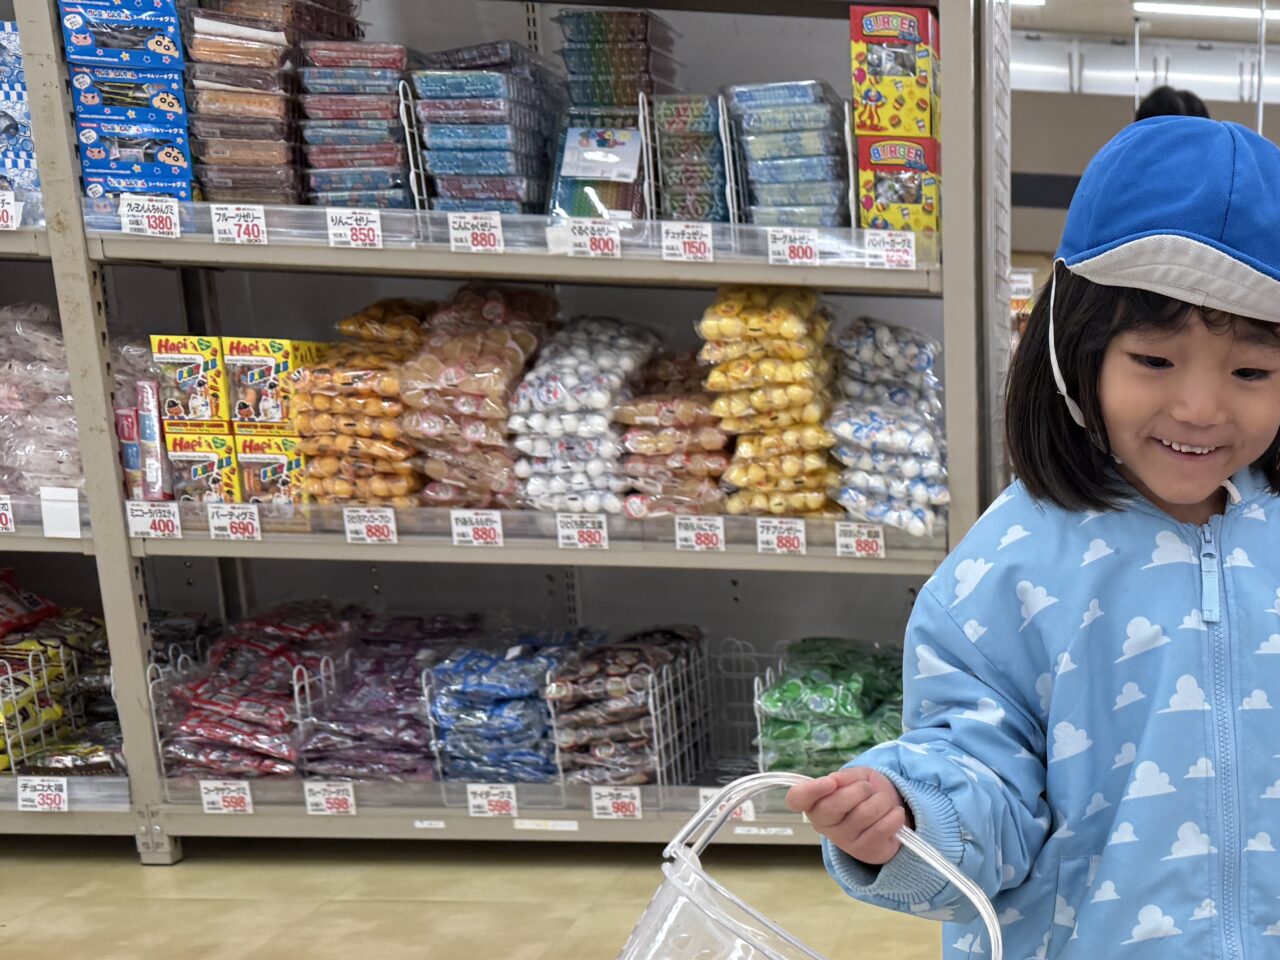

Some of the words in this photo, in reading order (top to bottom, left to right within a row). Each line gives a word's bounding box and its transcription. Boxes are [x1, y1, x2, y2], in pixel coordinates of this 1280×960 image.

[861, 13, 915, 32] BURGER
[871, 144, 923, 163] BURGER
[146, 215, 172, 231] 1380
[215, 213, 261, 222] フルーツゼリー
[331, 215, 376, 226] りんごゼリー
[234, 223, 263, 238] 740
[452, 220, 498, 231] こんにゃくゼリー
[350, 227, 375, 242] 850
[471, 232, 496, 247] 880
[590, 237, 614, 252] 800
[682, 241, 706, 255] 1150
[787, 246, 813, 261] 800
[210, 510, 255, 521] パーティグミ
[149, 519, 173, 533] 400
[229, 521, 254, 535] 690
[366, 524, 390, 538] 880
[473, 527, 496, 541] 880
[577, 530, 601, 544] 880
[695, 532, 718, 546] 880
[776, 535, 799, 549] 880
[855, 539, 879, 553] 880
[20, 783, 63, 793] チョコ大福
[37, 793, 61, 807] 350
[222, 796, 246, 809] 598
[612, 801, 636, 814] 980
